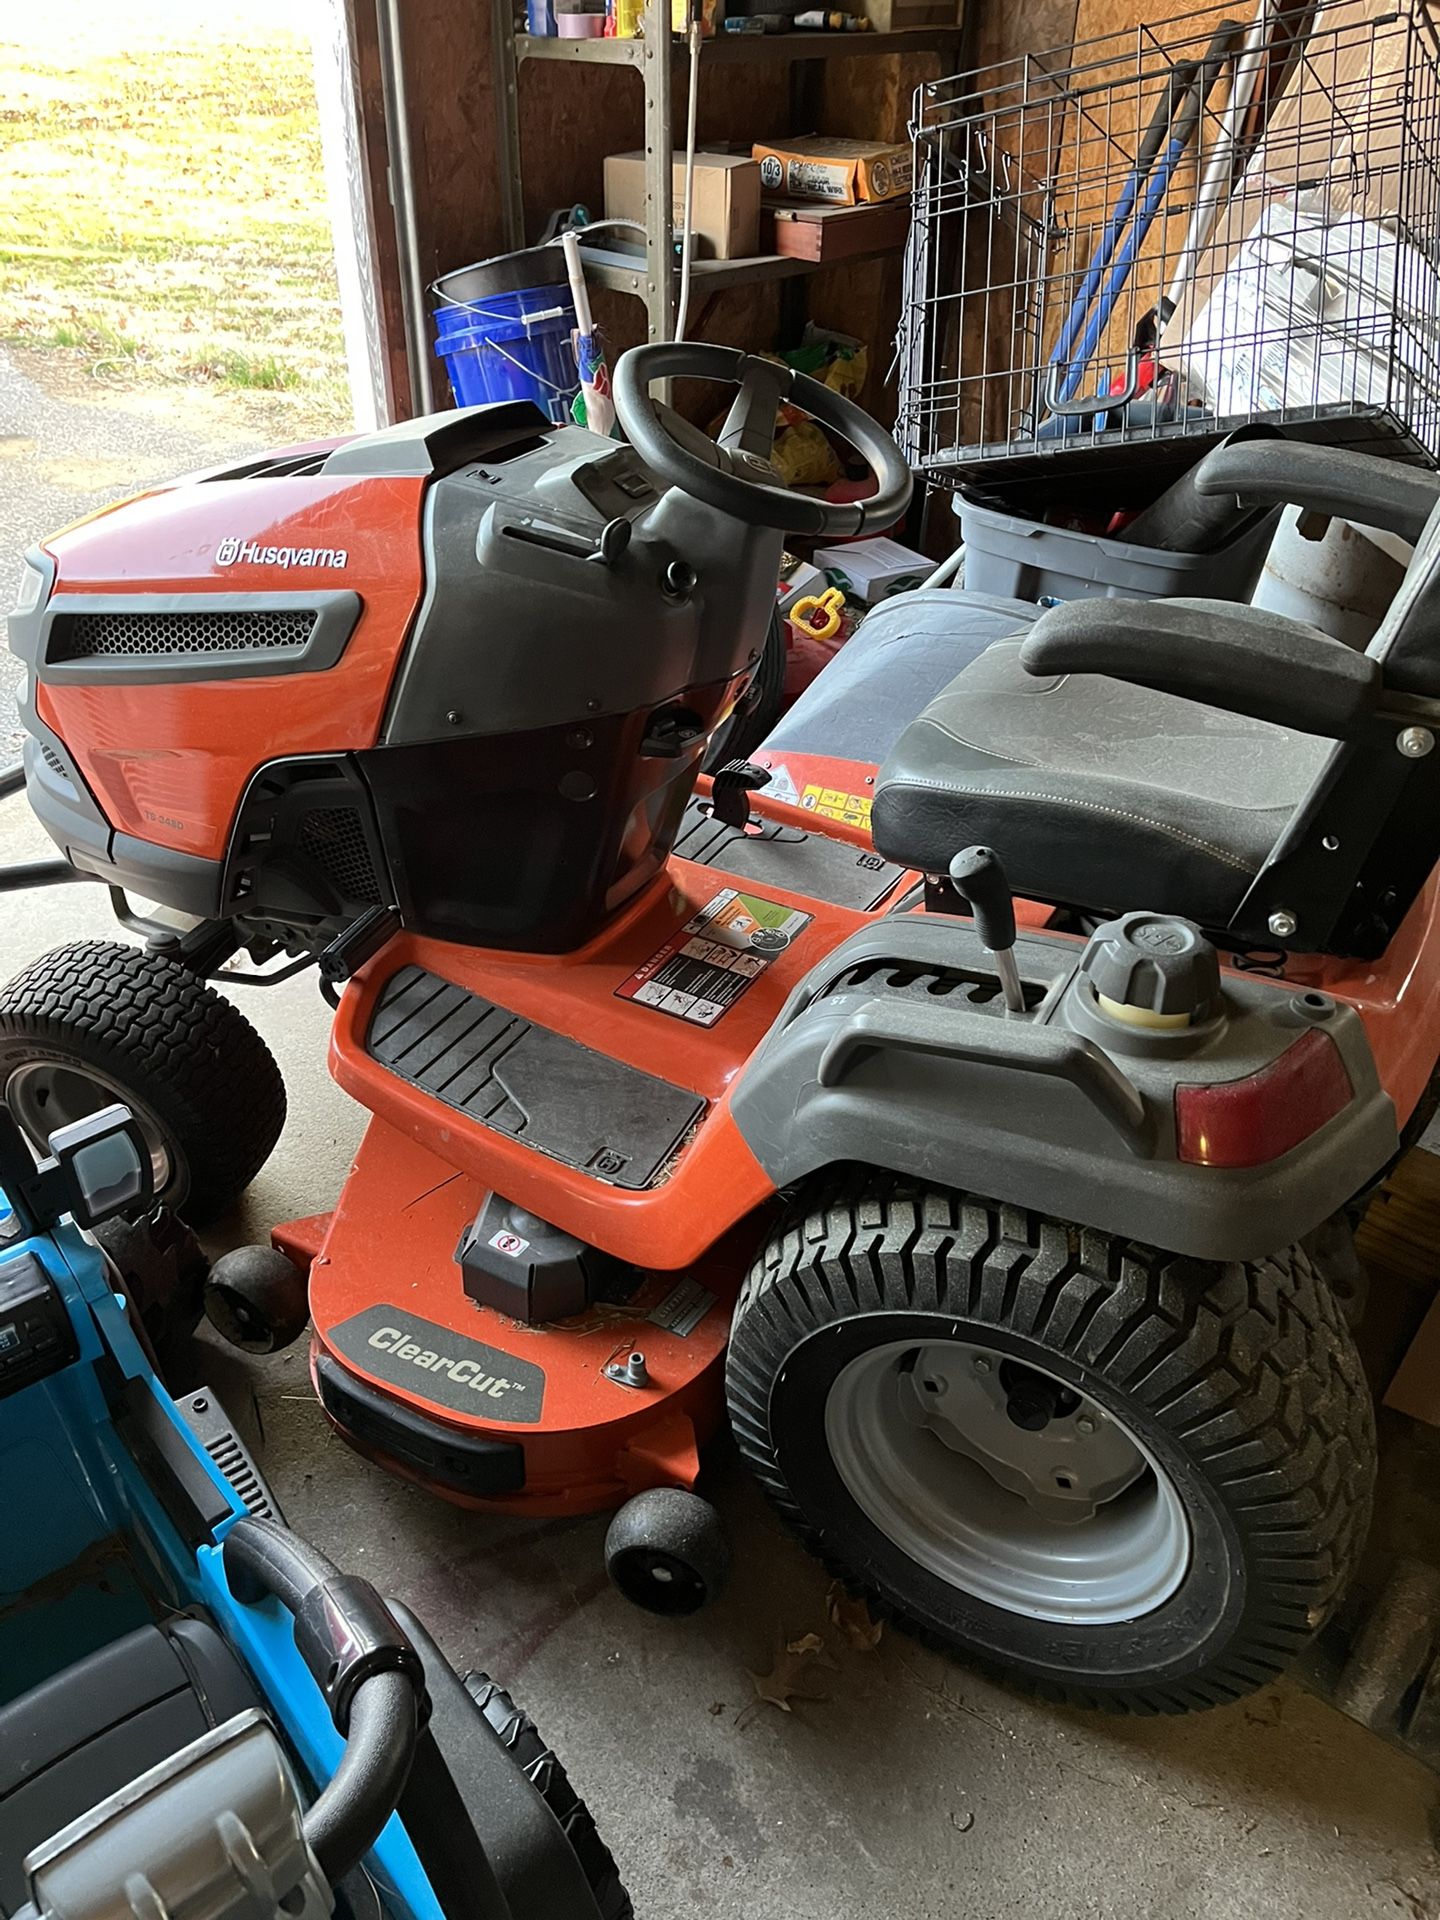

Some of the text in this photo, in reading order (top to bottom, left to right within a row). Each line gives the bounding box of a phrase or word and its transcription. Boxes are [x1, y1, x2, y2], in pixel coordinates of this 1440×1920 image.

[762, 162, 781, 177] 10/3
[236, 541, 349, 569] Husqvarna
[640, 944, 673, 973] DANGER
